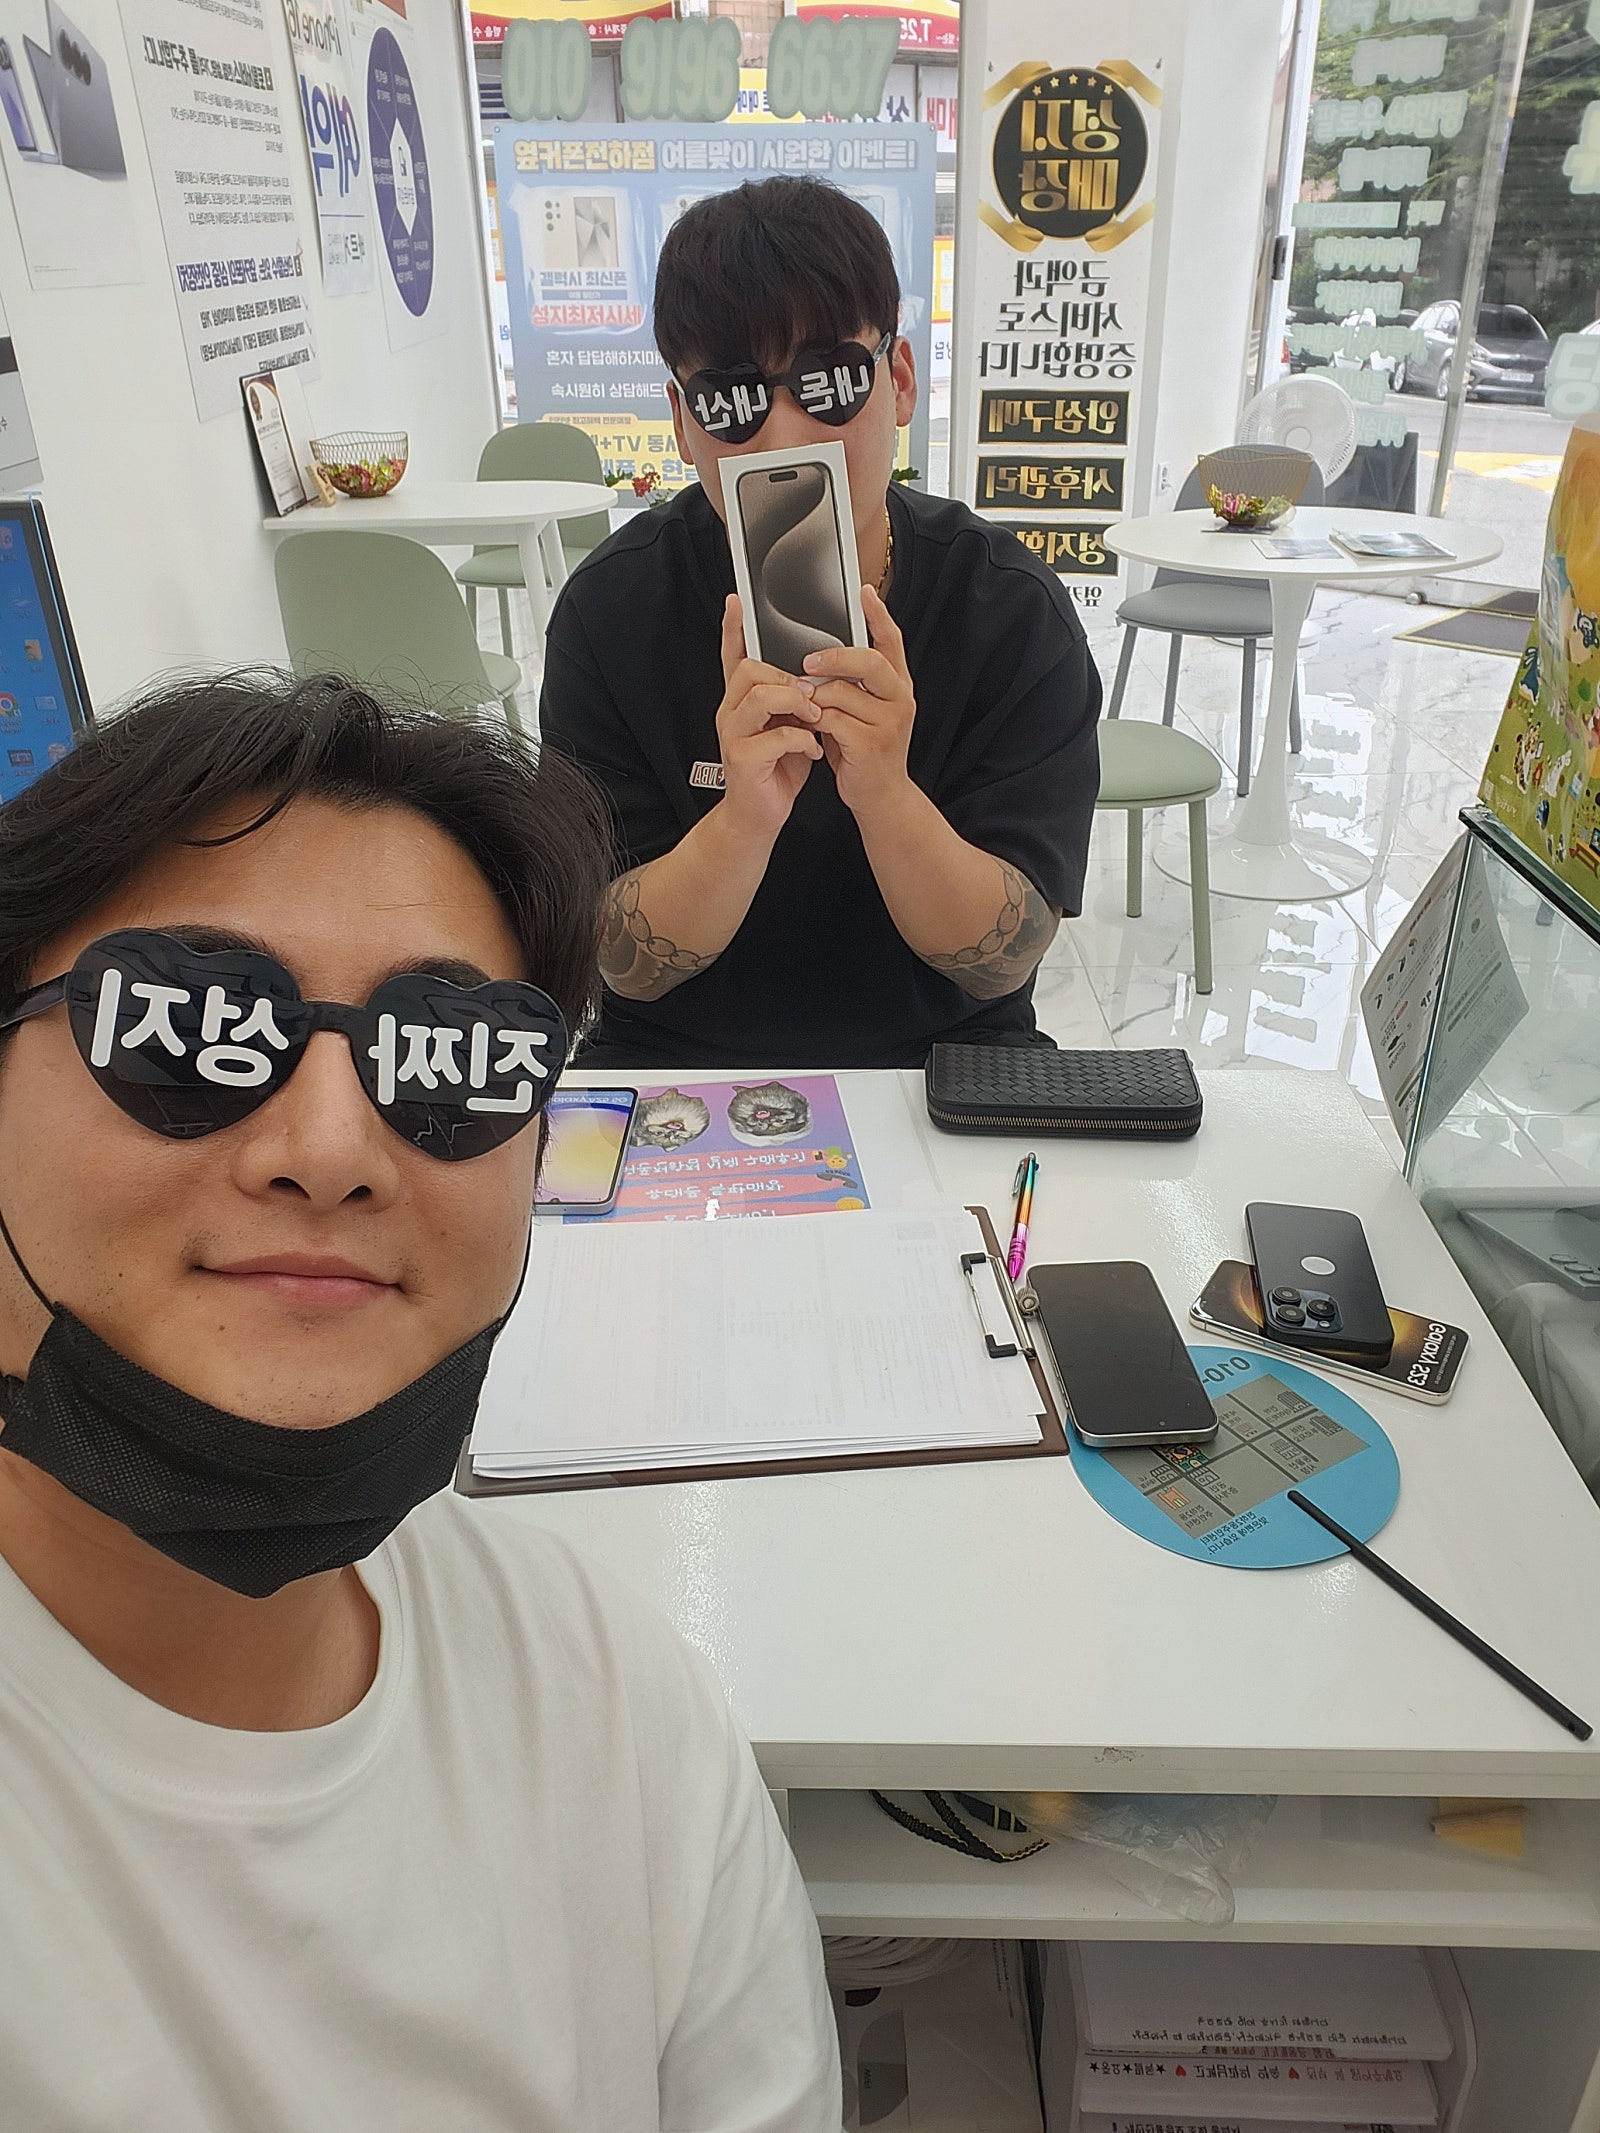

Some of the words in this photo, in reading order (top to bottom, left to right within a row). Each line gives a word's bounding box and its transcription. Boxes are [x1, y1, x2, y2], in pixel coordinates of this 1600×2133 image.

[505, 19, 591, 119] 010
[623, 18, 740, 118] 9196
[769, 18, 898, 116] 6637
[514, 140, 657, 172] 옆커폰전하점
[662, 140, 756, 171] 여름맞이
[761, 139, 833, 170] 시원한
[838, 140, 917, 170] 이벤트!
[540, 271, 582, 287] 갤럭시
[585, 271, 627, 287] 최신폰
[531, 305, 642, 326] 성지최저시세
[547, 351, 574, 366] 혼자
[551, 383, 605, 398] 속시원히
